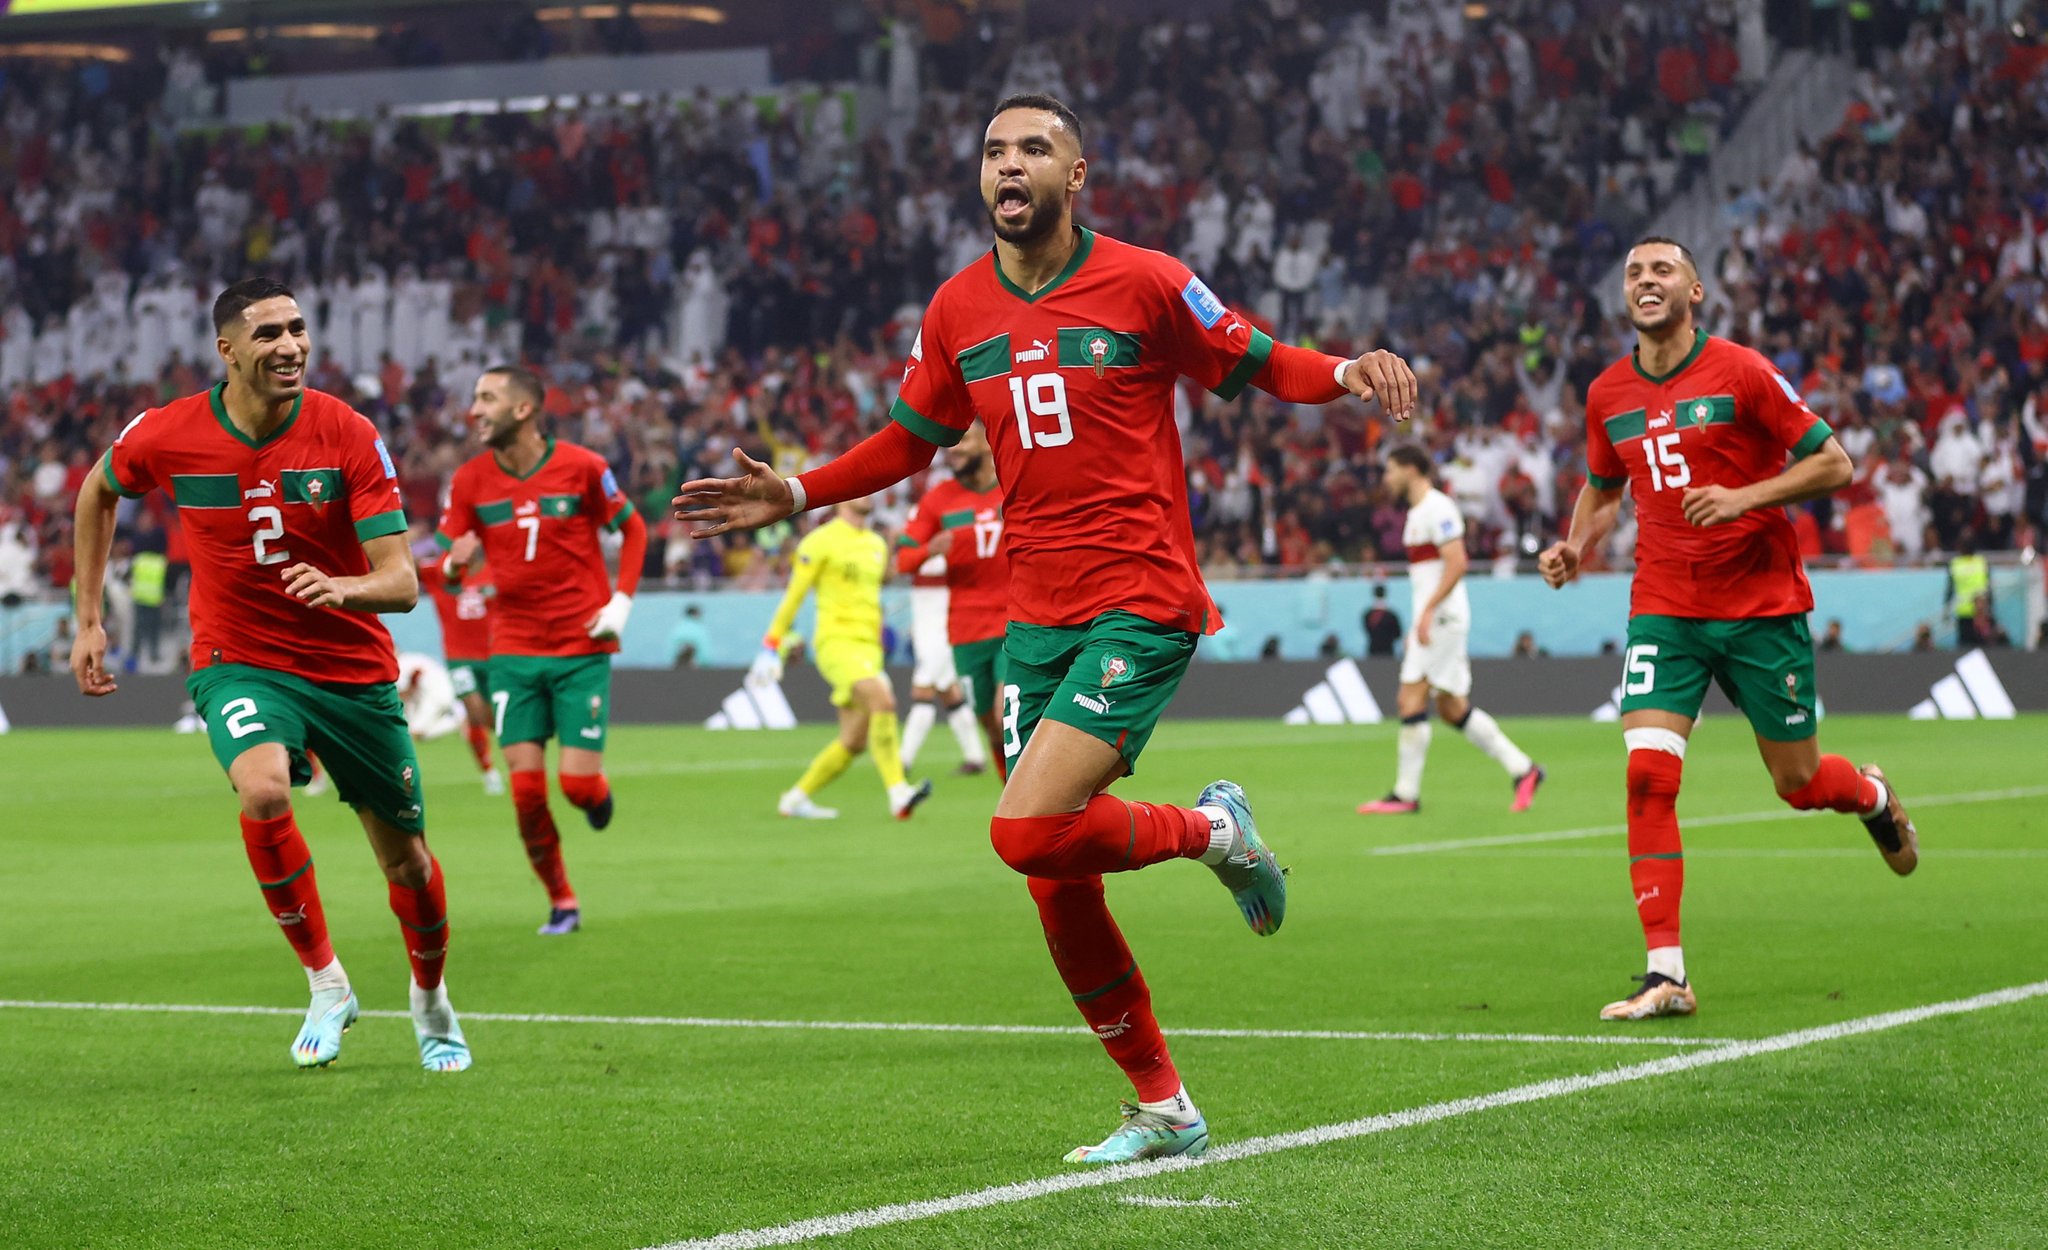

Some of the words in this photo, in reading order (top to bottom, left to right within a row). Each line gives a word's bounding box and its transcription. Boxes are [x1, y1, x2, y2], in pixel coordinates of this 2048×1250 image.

[1015, 349, 1044, 363] PUMA
[1008, 372, 1074, 449] 19
[1642, 432, 1691, 492] 15
[248, 506, 290, 565] 2
[517, 516, 540, 562] 7
[974, 521, 1003, 558] 17
[1621, 644, 1659, 699] 15
[221, 697, 267, 739] 2
[491, 690, 510, 737] 7
[1072, 692, 1105, 715] PUMA
